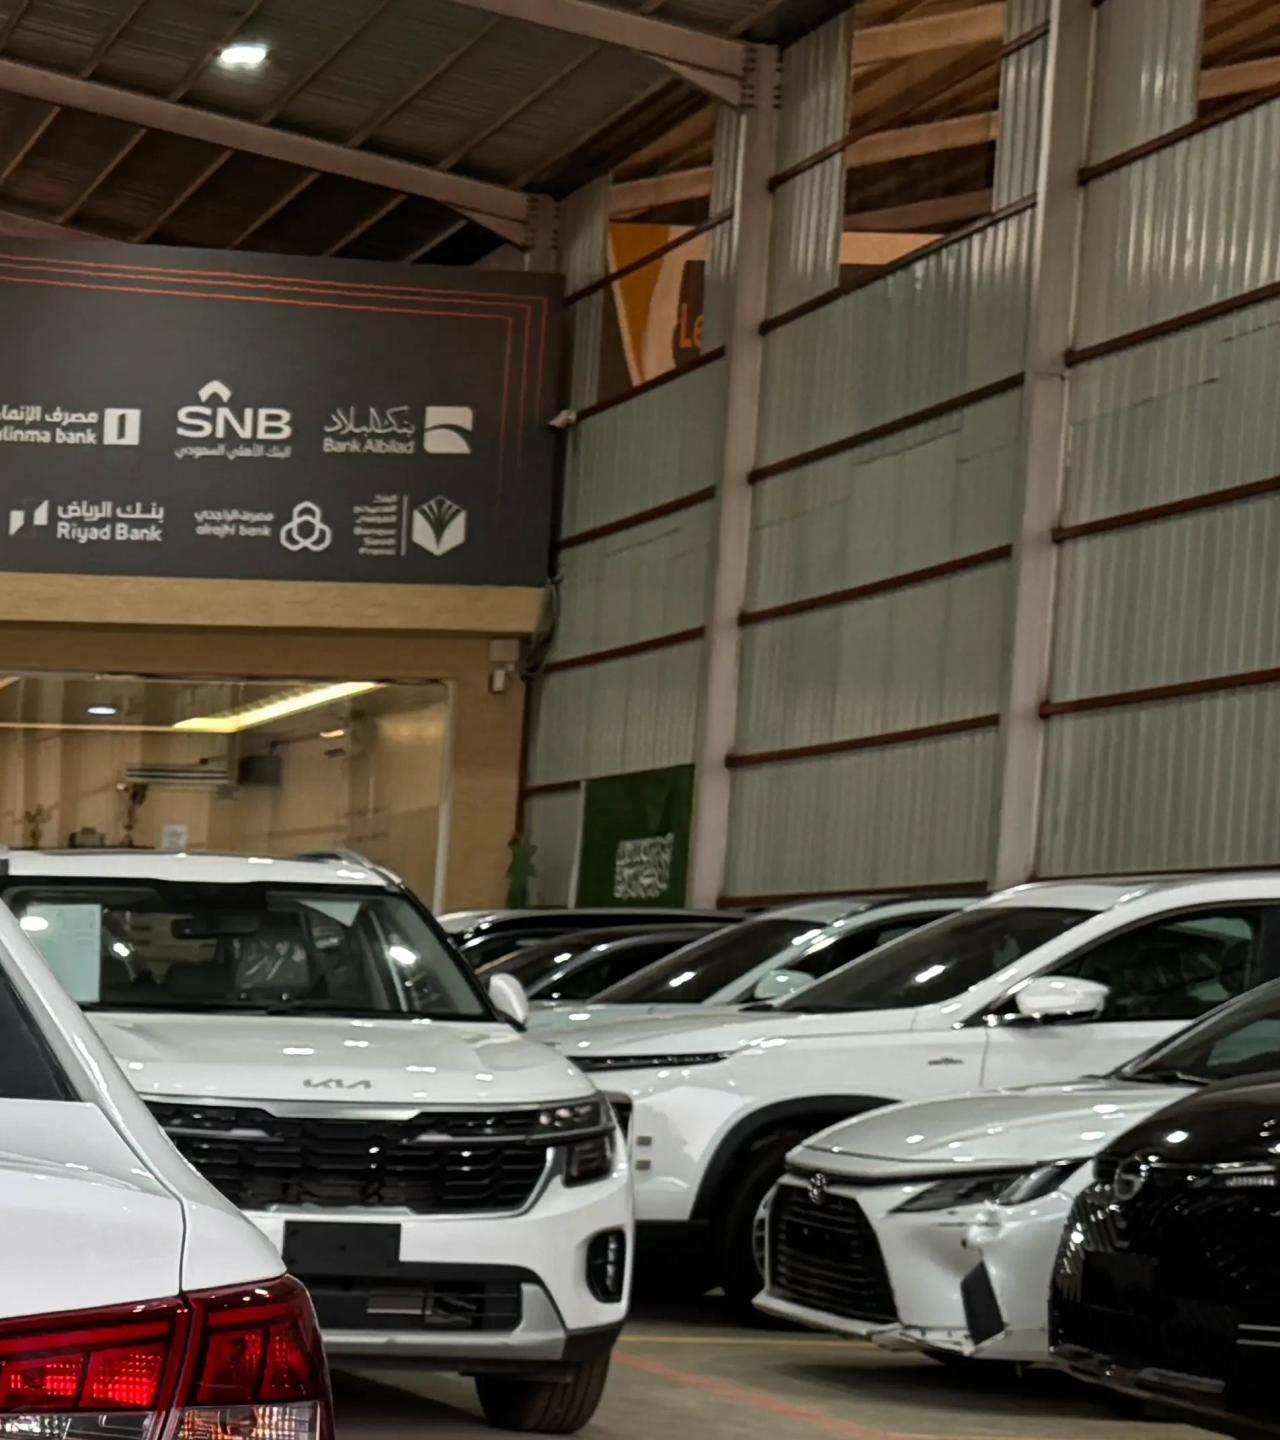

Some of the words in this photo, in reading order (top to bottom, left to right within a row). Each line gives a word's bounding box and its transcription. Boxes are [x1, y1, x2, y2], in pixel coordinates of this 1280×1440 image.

[44, 405, 100, 427] مصرف
[175, 405, 293, 441] SNB
[55, 427, 98, 446] bank
[323, 437, 363, 454] Bank
[56, 500, 113, 522] الرياض
[115, 502, 166, 524] بنك
[56, 521, 112, 545] Riyad
[115, 523, 164, 543] Bank
